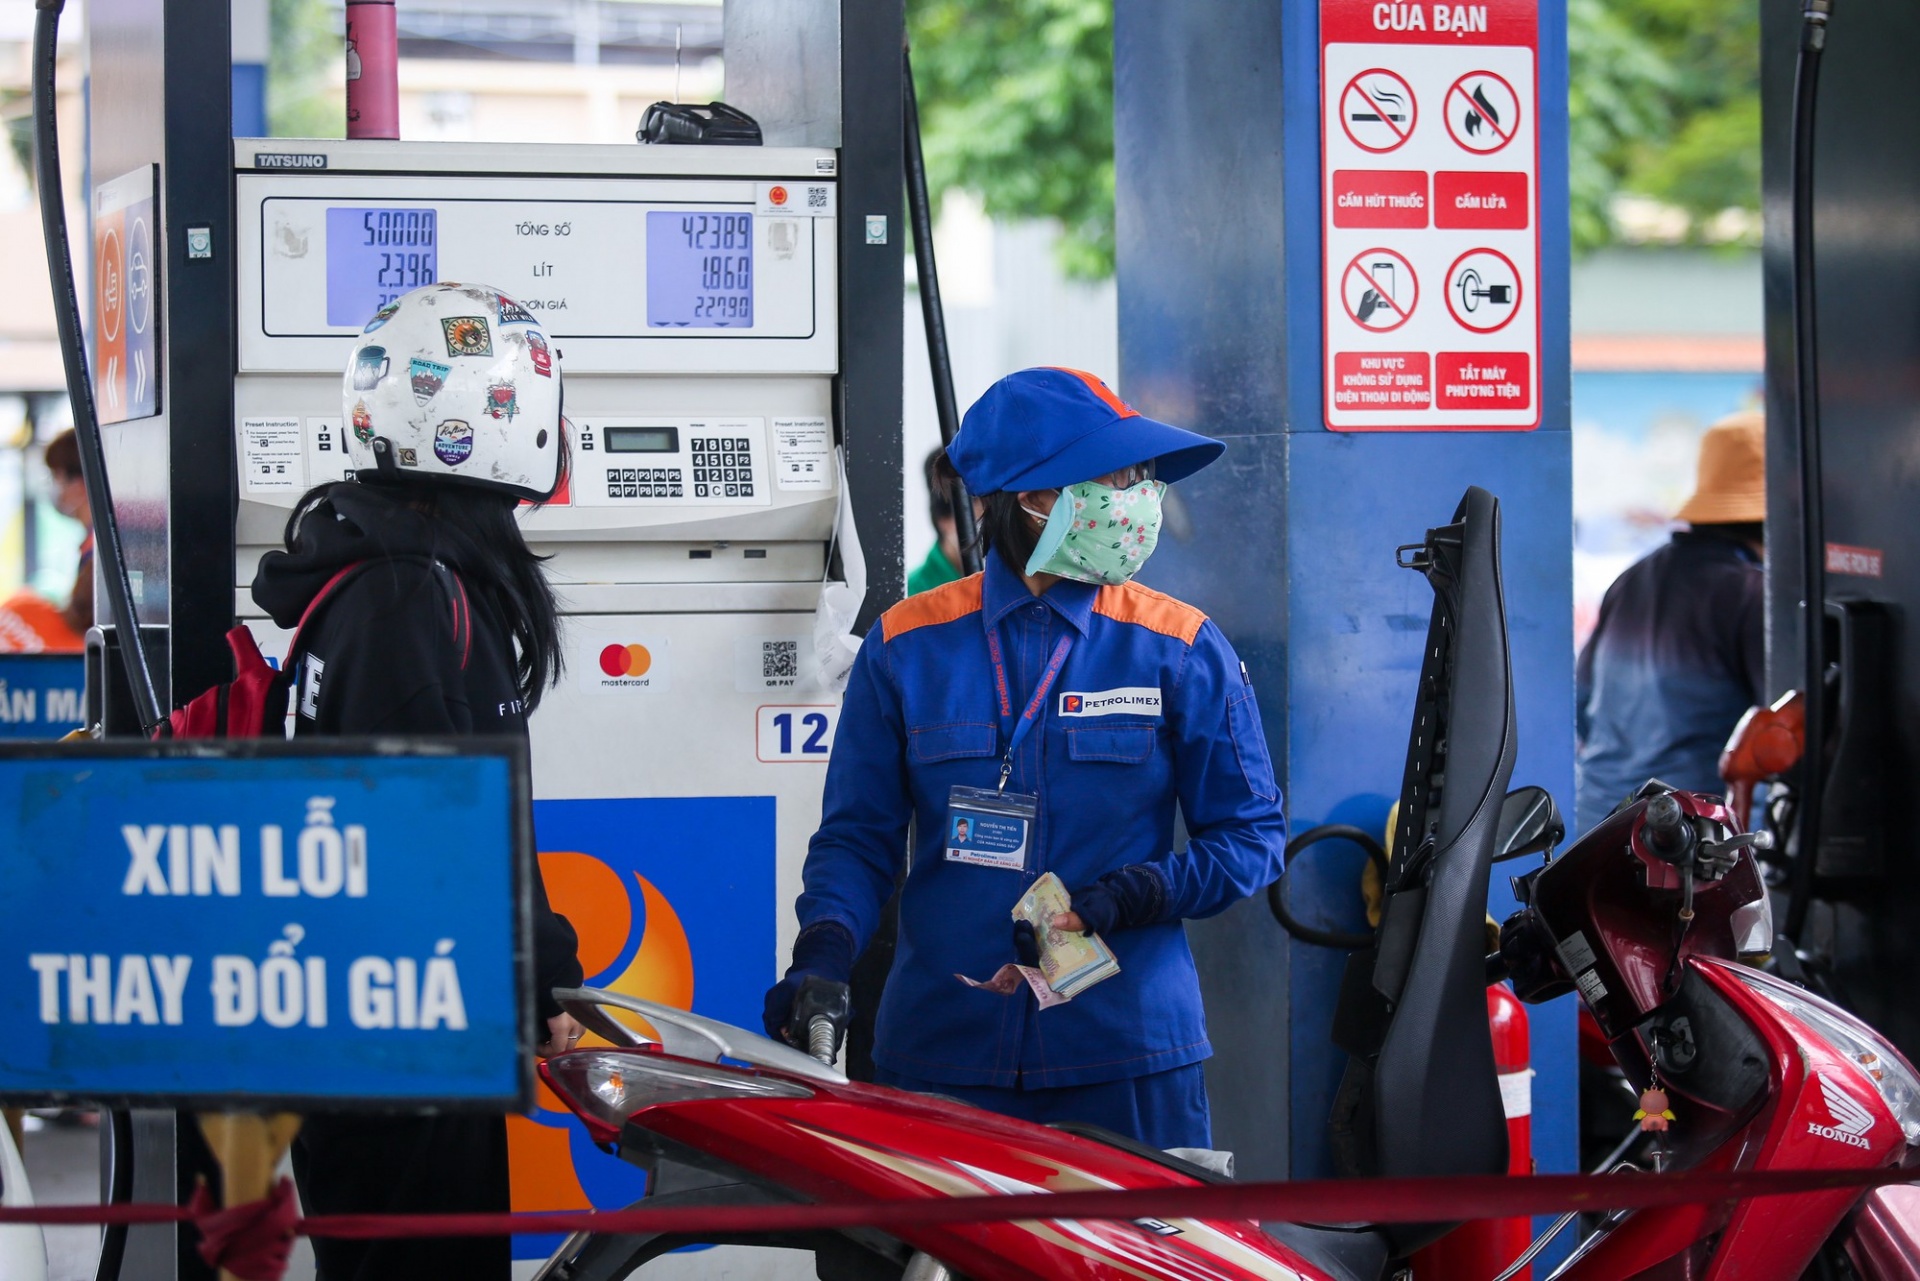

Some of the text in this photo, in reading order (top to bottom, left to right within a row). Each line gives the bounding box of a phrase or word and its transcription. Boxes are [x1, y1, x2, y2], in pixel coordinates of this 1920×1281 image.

[1433, 5, 1487, 38] BẠN
[259, 155, 324, 167] TATSUNO
[1338, 192, 1363, 208] CẤM
[1455, 193, 1480, 209] CẤM
[364, 212, 433, 246] 50000
[515, 221, 572, 236] TỔNG SỐ
[682, 216, 749, 249] 42389
[533, 262, 554, 277] LÍT
[548, 299, 568, 310] GIÁ
[695, 297, 749, 318] 22790
[1361, 358, 1380, 369] KHU
[1482, 366, 1507, 380] MÁY
[1391, 392, 1401, 403] DI
[694, 440, 701, 450] 7
[709, 440, 717, 450] 8
[724, 440, 732, 450] 9
[696, 456, 703, 465] 4
[710, 456, 718, 465] 5
[726, 456, 733, 465] 6
[609, 472, 681, 480] P1 P2 P3 P4 P5
[697, 471, 703, 480] 1
[711, 471, 720, 480] 2
[727, 471, 734, 480] 3
[610, 486, 683, 495] P6 P7 P8 P9 P10
[698, 486, 706, 496] 0
[713, 486, 721, 495] C
[601, 678, 650, 687] mastercard
[995, 664, 1011, 717] Petrolimex
[1024, 670, 1056, 720] Petrolimex
[1085, 696, 1160, 709] PETROLIMEX
[774, 713, 828, 753] 12
[121, 796, 368, 898] XIN LỖI
[970, 852, 998, 860] Petrolimex
[29, 924, 469, 1030] THAY ĐỔI GIÁ
[1807, 1122, 1871, 1150] HONDA
